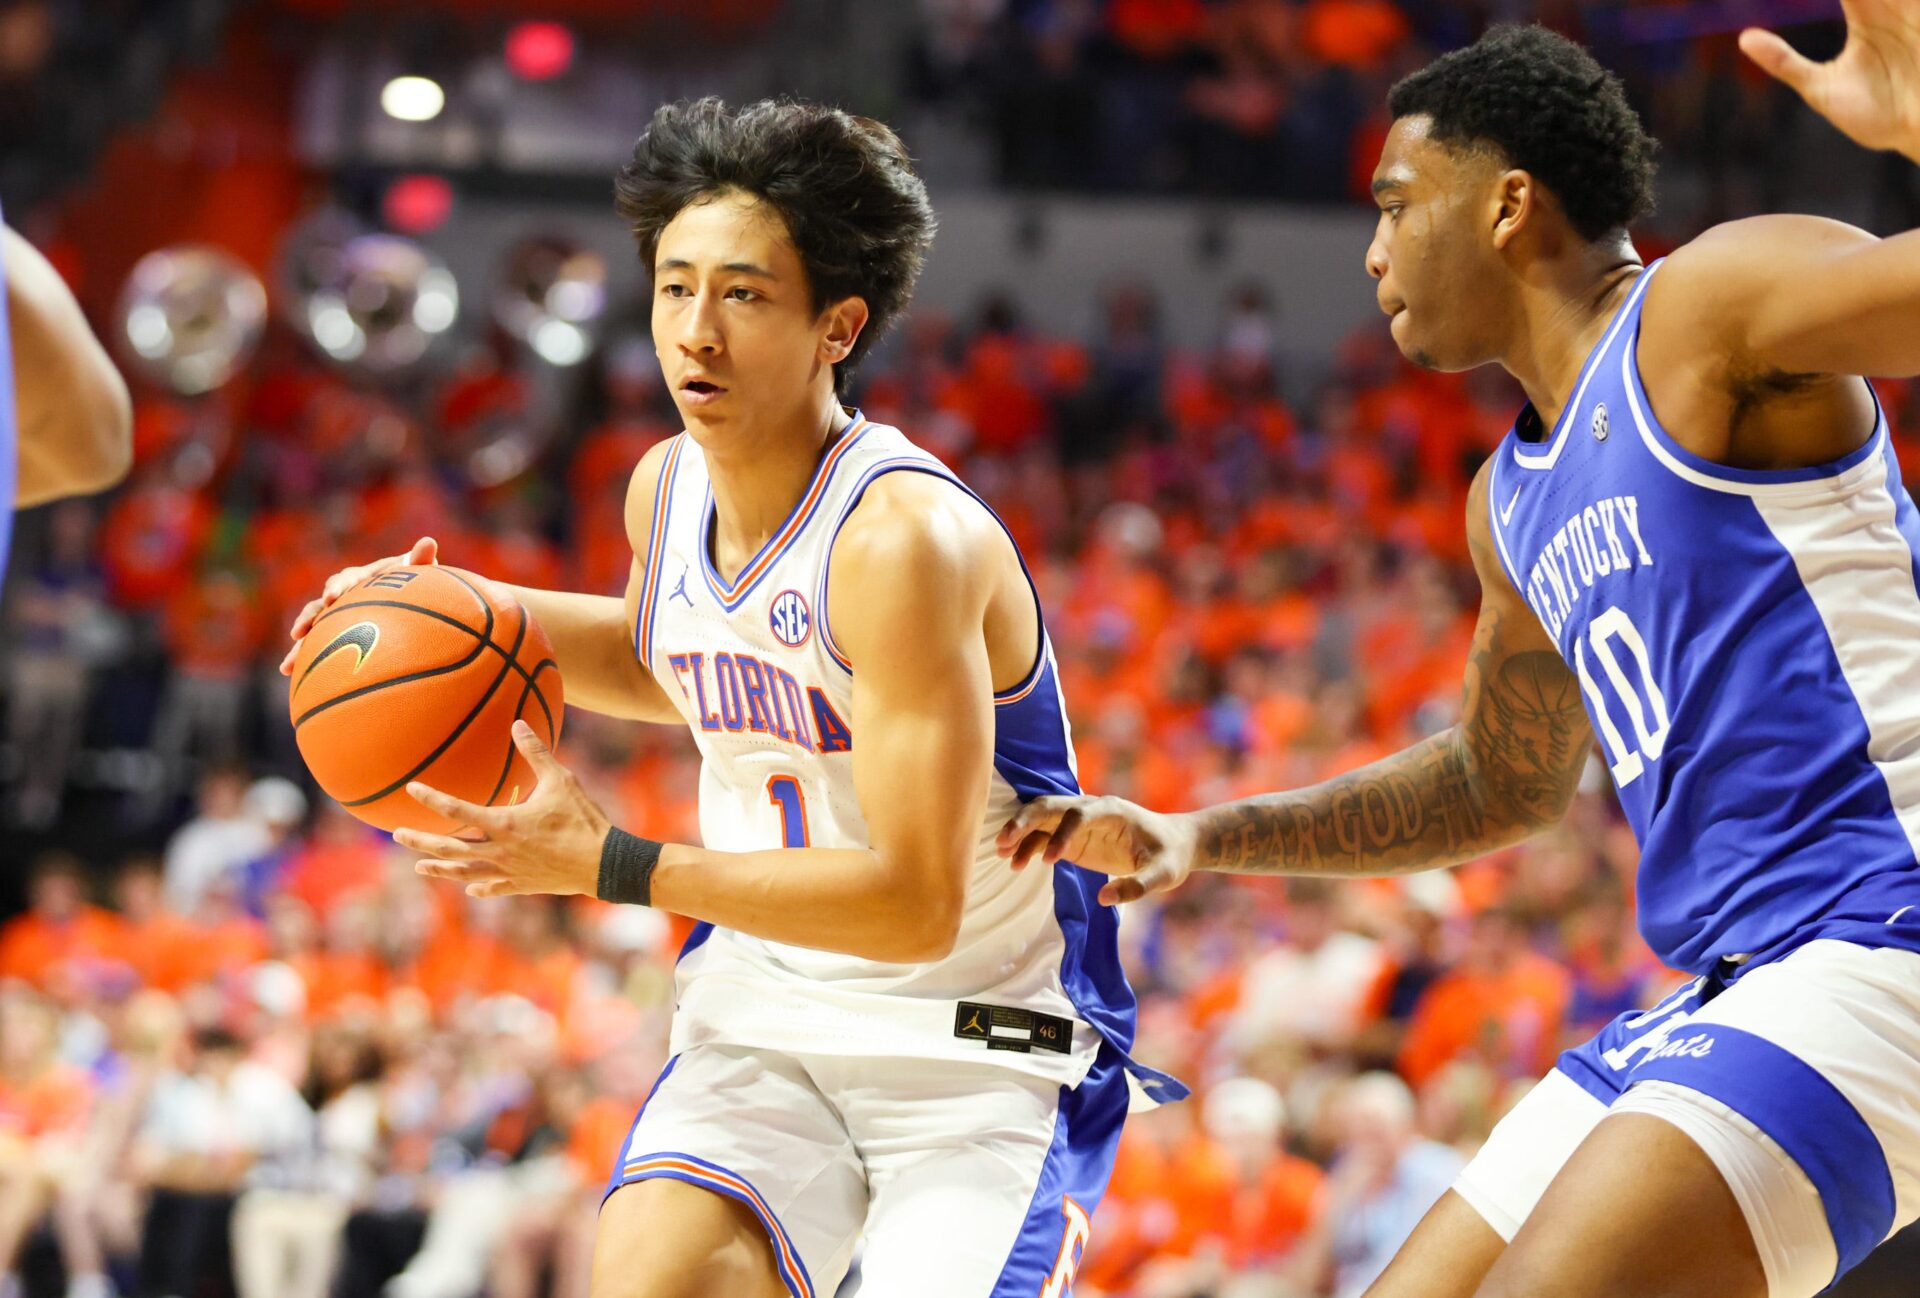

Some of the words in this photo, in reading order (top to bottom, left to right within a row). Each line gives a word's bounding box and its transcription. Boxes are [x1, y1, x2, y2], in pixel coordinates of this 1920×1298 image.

[772, 591, 809, 646] SEC
[1574, 605, 1671, 789] 10
[766, 774, 810, 849] 1
[1213, 803, 1322, 870] FEAR
[1330, 772, 1424, 871] GOD
